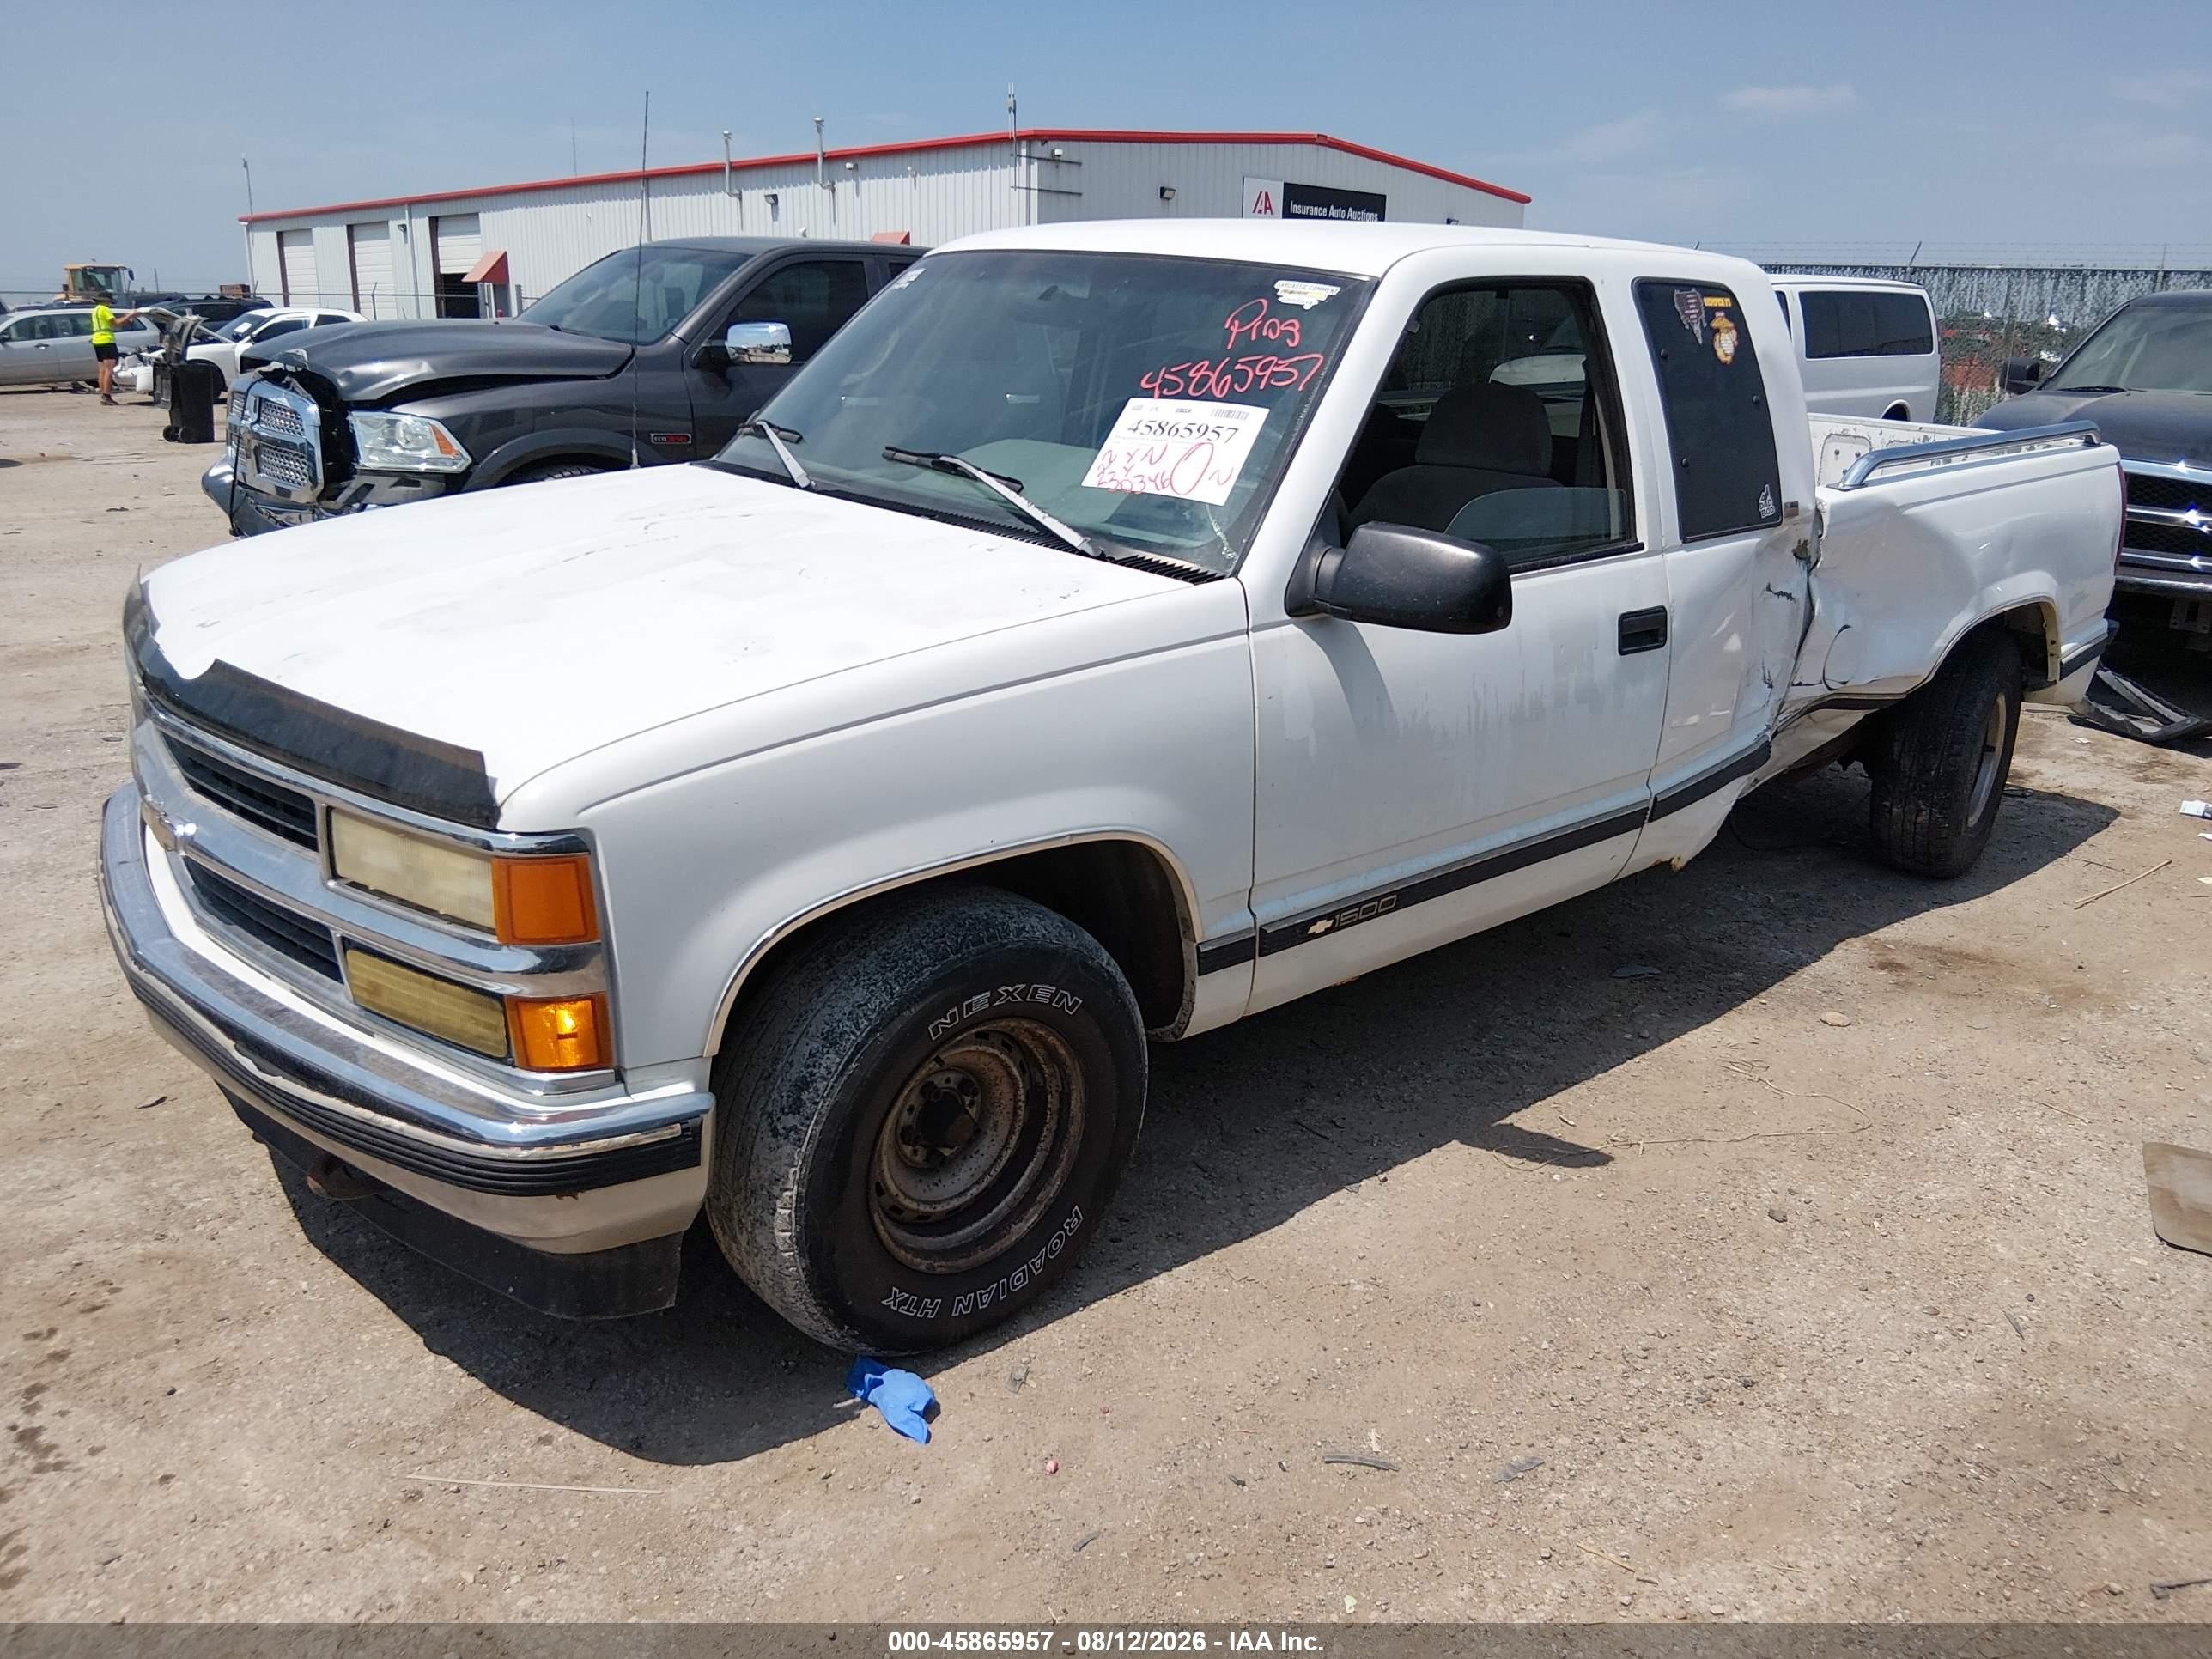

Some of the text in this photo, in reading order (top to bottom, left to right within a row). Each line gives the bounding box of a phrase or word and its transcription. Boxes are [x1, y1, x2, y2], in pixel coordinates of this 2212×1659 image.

[1290, 200, 1379, 222] Insurance Auto Auctions
[1140, 353, 1325, 399] 45865957
[1127, 418, 1240, 444] 45865957
[1334, 895, 1397, 928] 1500
[927, 983, 1084, 1041] NEXEN
[881, 1205, 1084, 1319] ROADIAN HTX
